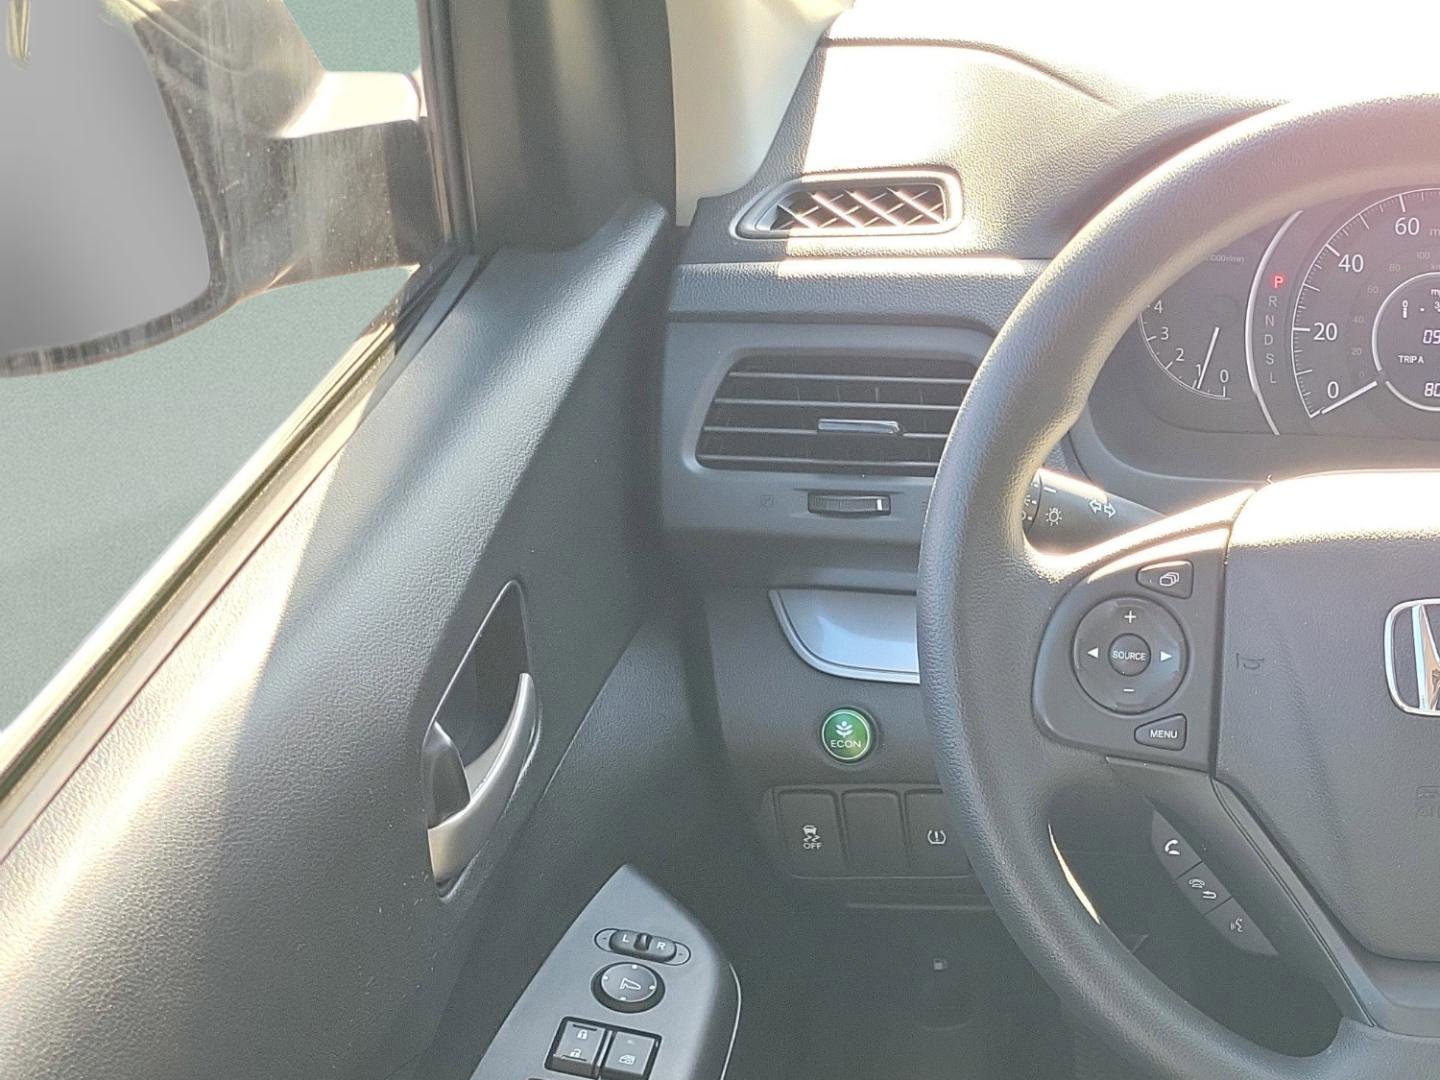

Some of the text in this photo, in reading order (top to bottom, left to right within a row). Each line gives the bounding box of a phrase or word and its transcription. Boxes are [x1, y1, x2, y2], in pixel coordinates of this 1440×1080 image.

[1395, 218, 1420, 236] 60
[1338, 254, 1364, 272] 40
[1274, 276, 1284, 288] P
[1153, 300, 1163, 314] 4
[1268, 296, 1278, 308] R
[1402, 300, 1409, 308] 0
[1265, 315, 1275, 327] N
[1160, 326, 1170, 340] 3
[1314, 323, 1338, 341] 20
[1264, 334, 1273, 346] D
[1175, 348, 1185, 362] 2
[1265, 353, 1274, 366] S
[1398, 355, 1416, 364] TRIP
[1195, 364, 1202, 377] 1
[1219, 370, 1229, 383] 0
[1269, 372, 1277, 385] L
[1327, 381, 1339, 399] 0
[1112, 649, 1146, 662] SOURCE
[1150, 729, 1178, 739] MENU
[830, 739, 862, 749] ECON
[802, 842, 823, 851] OFF
[621, 934, 666, 950] L R
